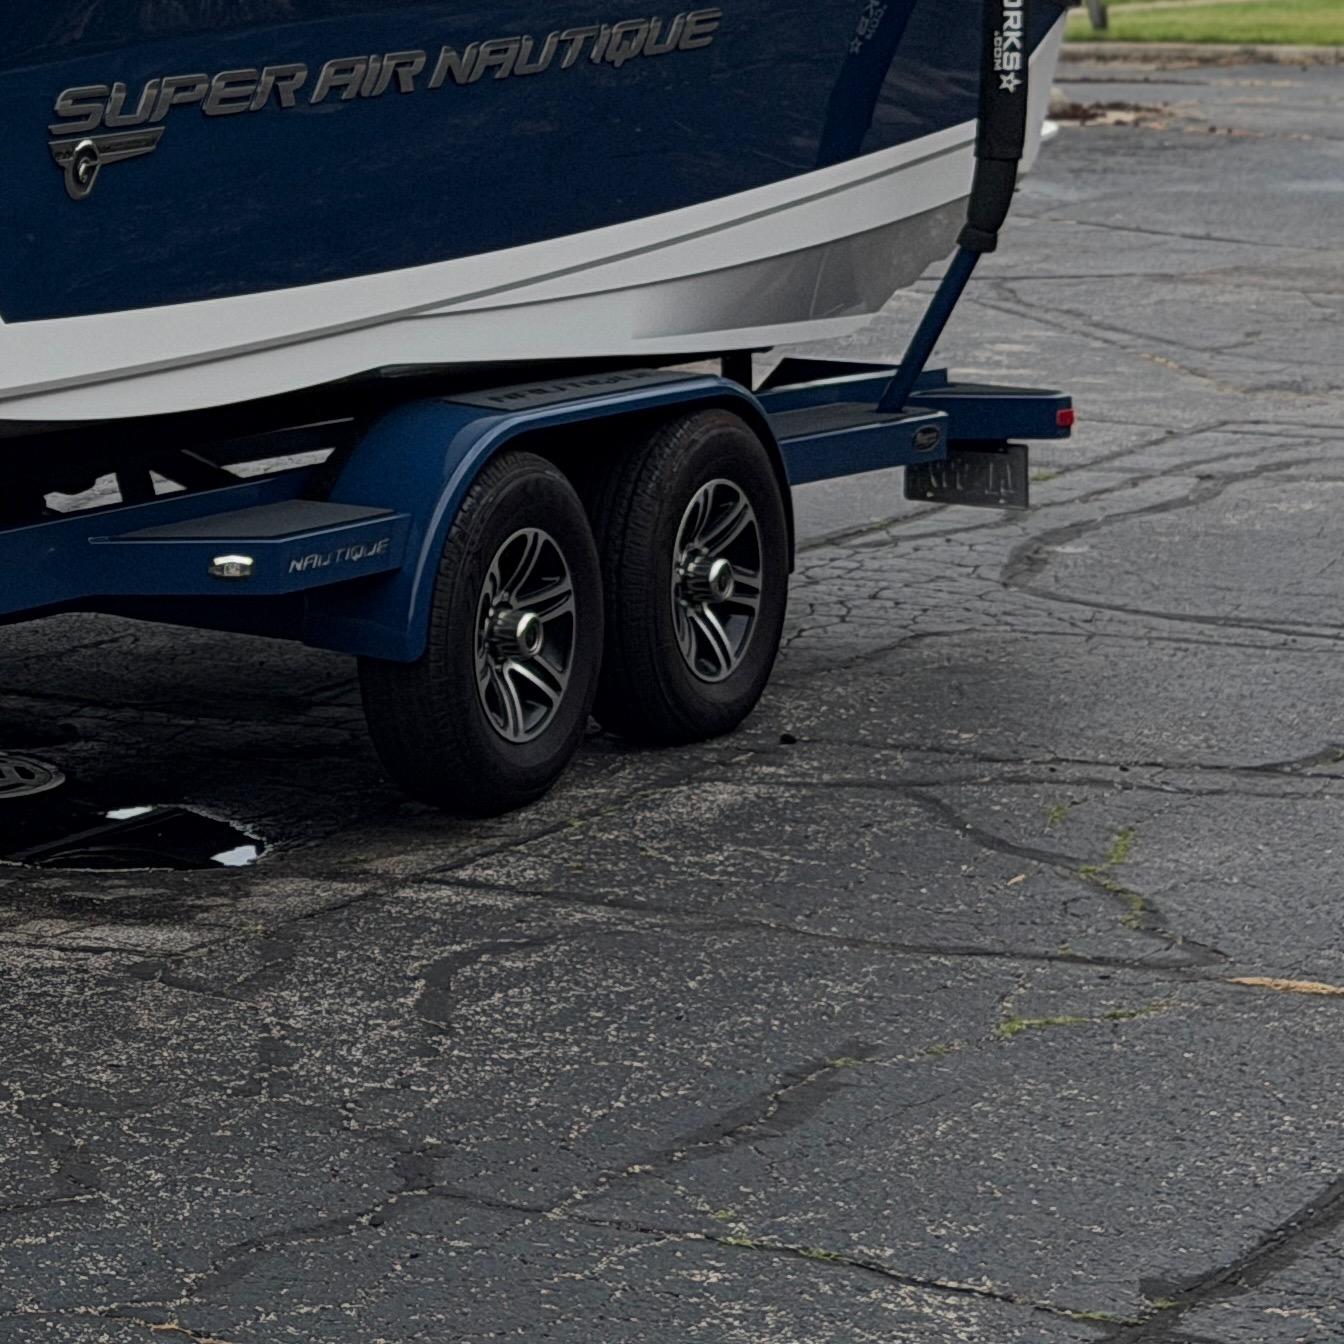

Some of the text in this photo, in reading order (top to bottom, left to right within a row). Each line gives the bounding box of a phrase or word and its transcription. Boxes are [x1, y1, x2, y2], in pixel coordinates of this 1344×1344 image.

[993, 30, 1002, 71] .COM
[48, 8, 723, 135] SUPER AIR NAUTIQUE
[288, 538, 391, 574] NAUTIQUE
